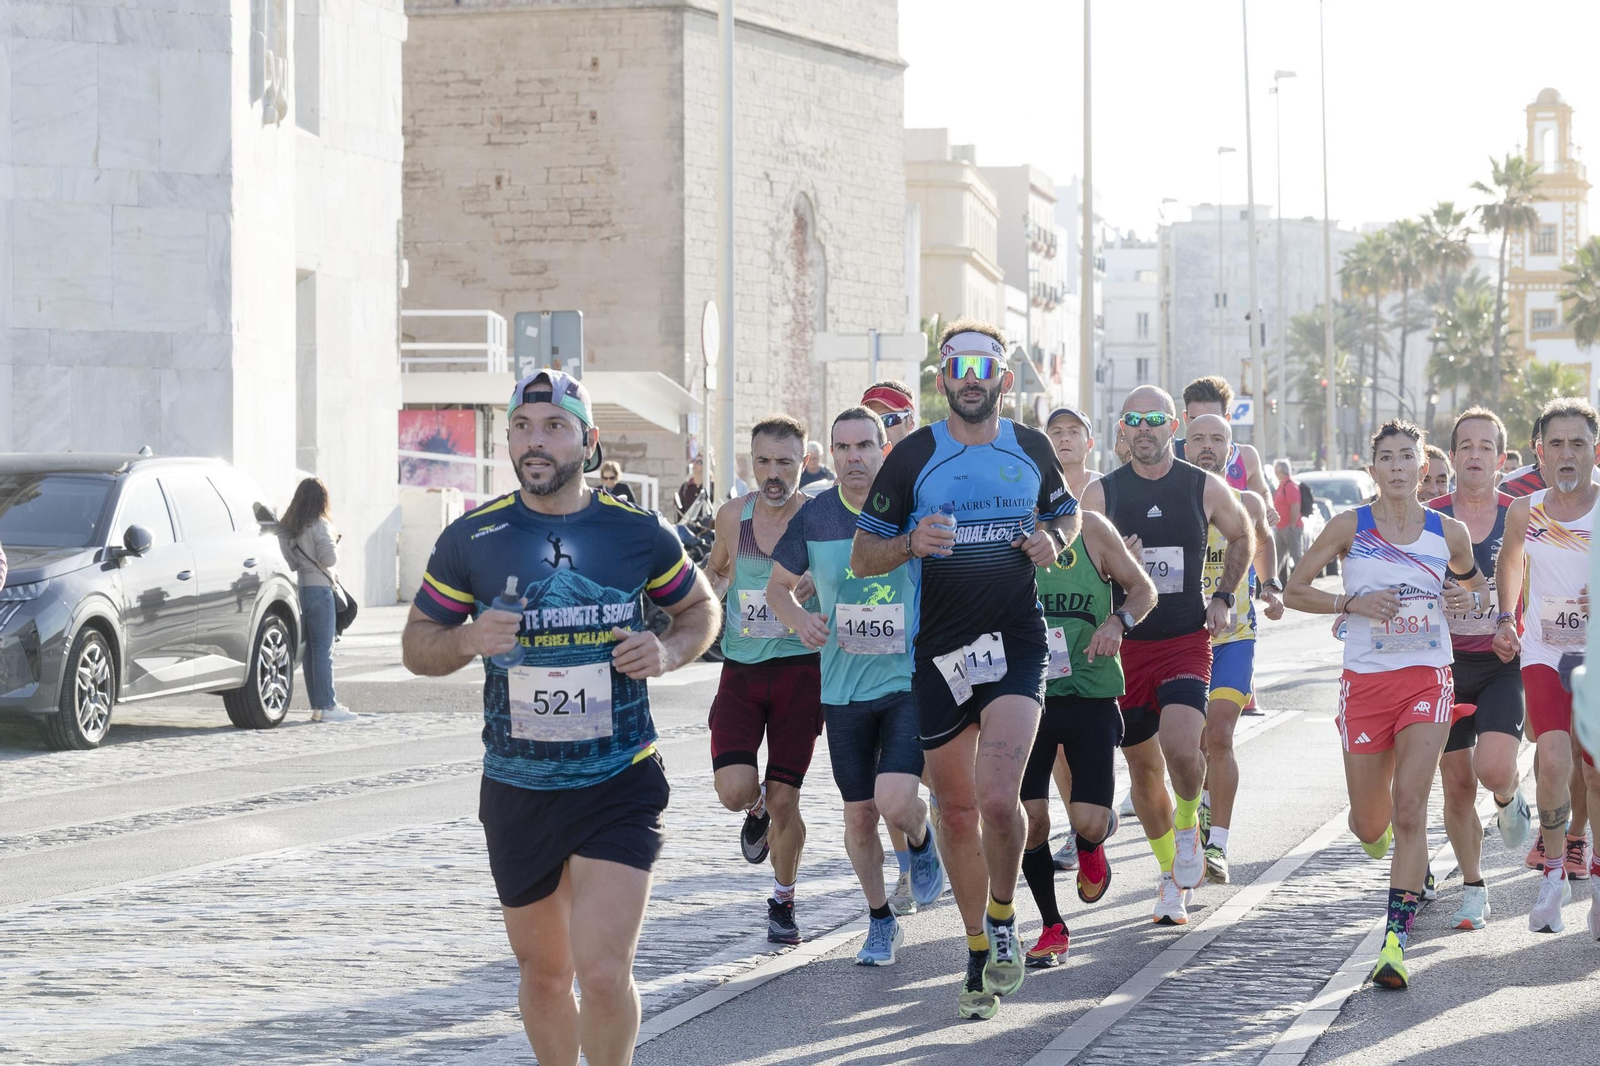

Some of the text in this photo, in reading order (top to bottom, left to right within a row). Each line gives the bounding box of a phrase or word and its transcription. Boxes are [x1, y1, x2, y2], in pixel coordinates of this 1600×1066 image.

[952, 500, 991, 513] LAURUS
[1141, 561, 1169, 578] 79
[1040, 593, 1094, 612] ERDE
[523, 609, 540, 630] TE
[747, 604, 778, 622] 24
[844, 619, 895, 638] 1456
[1381, 614, 1431, 635] 1381
[534, 630, 570, 648] PÉREZ
[533, 688, 586, 716] 521
